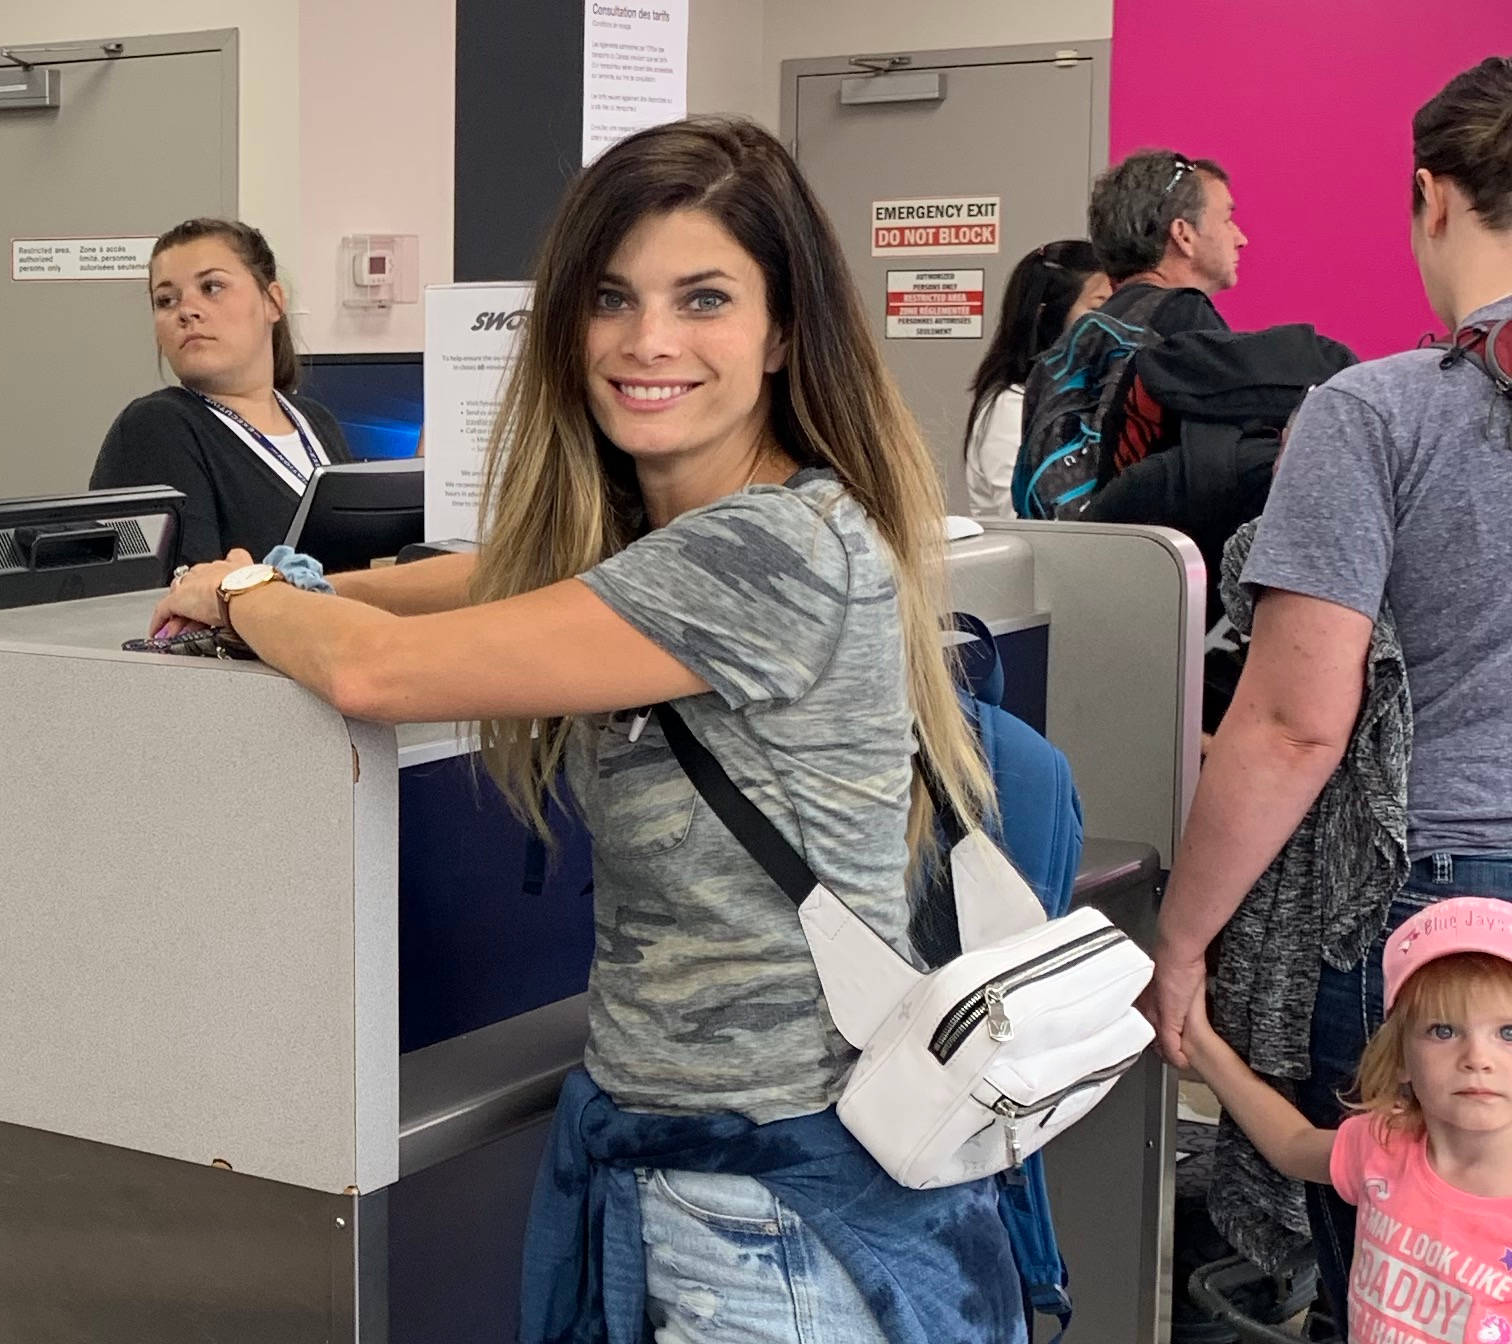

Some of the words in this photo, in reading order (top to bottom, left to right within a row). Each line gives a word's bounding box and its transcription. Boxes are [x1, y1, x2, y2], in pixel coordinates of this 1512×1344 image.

[592, 2, 637, 19] Consultation
[638, 8, 651, 20] des
[875, 205, 963, 221] EMERGENCY
[967, 203, 997, 218] EXIT
[878, 229, 900, 246] DO
[904, 228, 936, 245] NOT
[939, 226, 993, 243] BLOCK
[79, 246, 97, 254] Zone
[48, 264, 61, 273] only
[1424, 915, 1457, 936] Blue
[1366, 1207, 1402, 1244] MAY
[1399, 1227, 1459, 1275] LOOK
[1455, 1256, 1512, 1301] LIKE
[1354, 1246, 1465, 1335] DADDY
